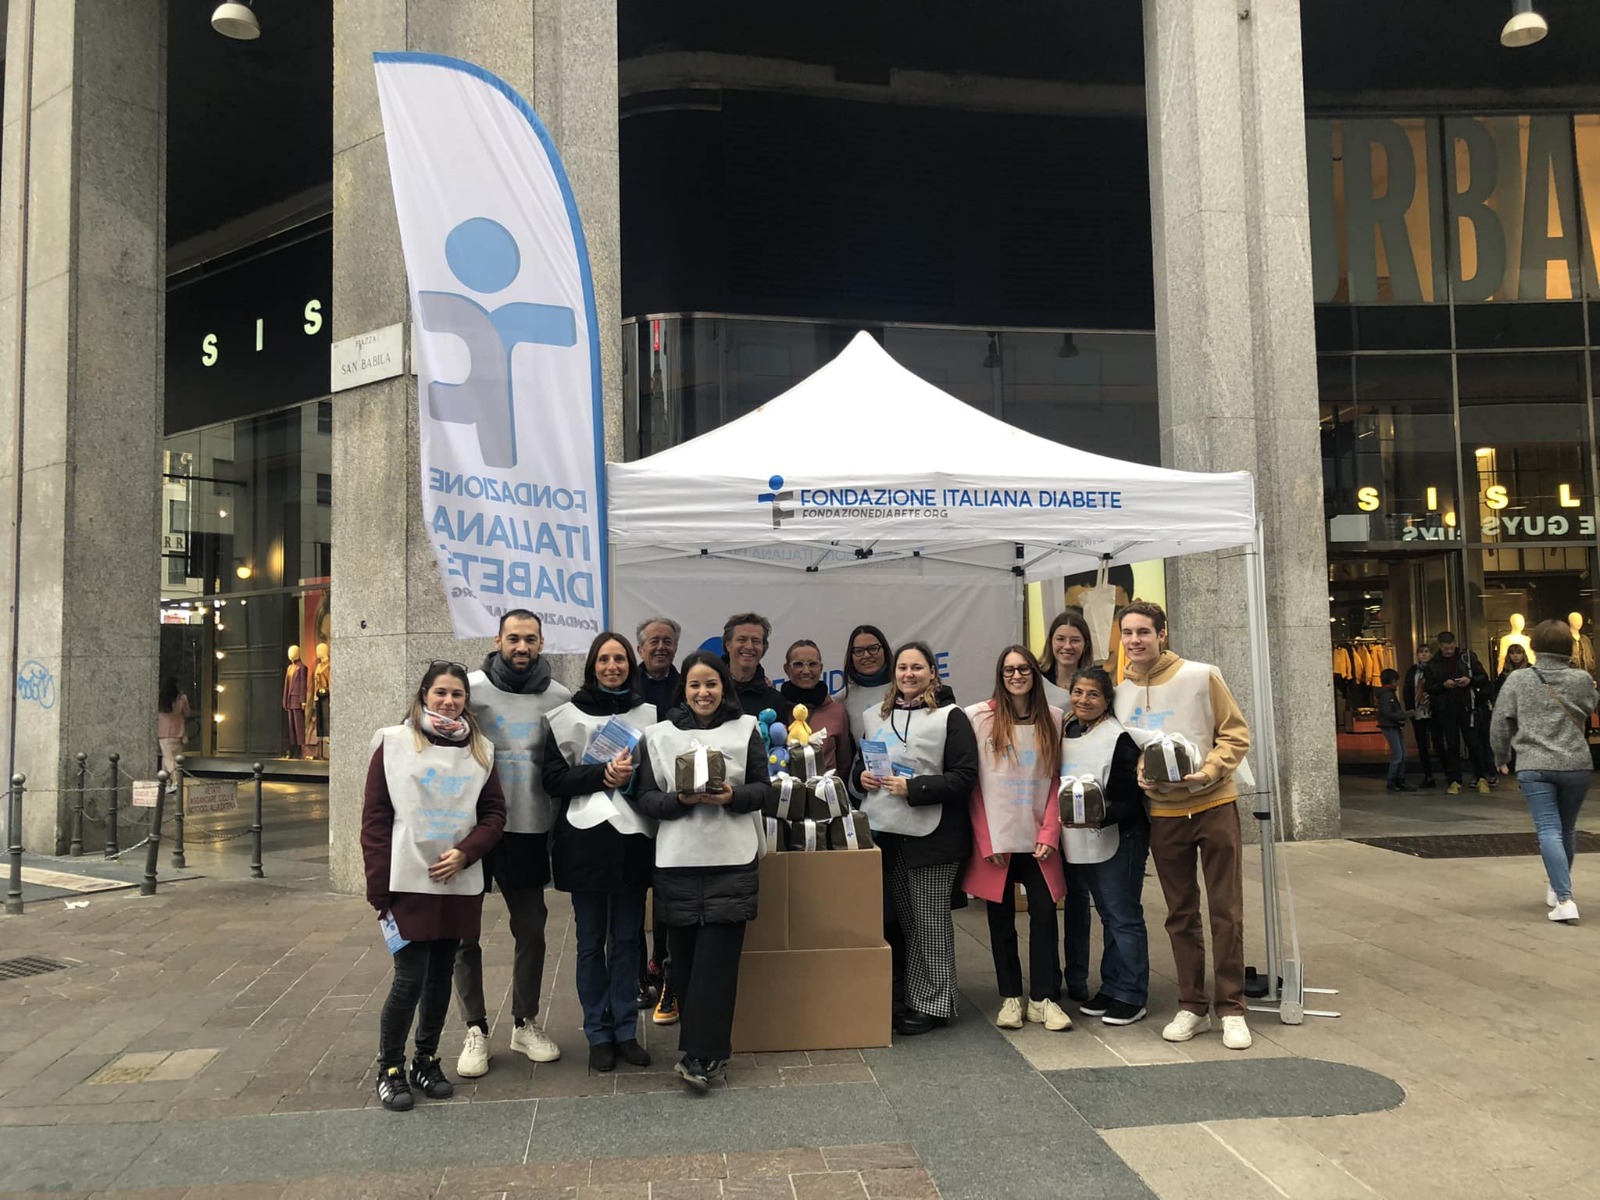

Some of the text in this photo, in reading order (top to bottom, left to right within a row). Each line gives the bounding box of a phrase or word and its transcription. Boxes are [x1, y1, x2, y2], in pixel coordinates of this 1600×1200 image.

[355, 335, 377, 348] PIAZZA
[341, 353, 391, 375] SAN BABILA
[801, 489, 1122, 508] FONDAZIONE ITALIANA DIABETE
[802, 508, 949, 519] FONDAZIONEDIABETE.ORG
